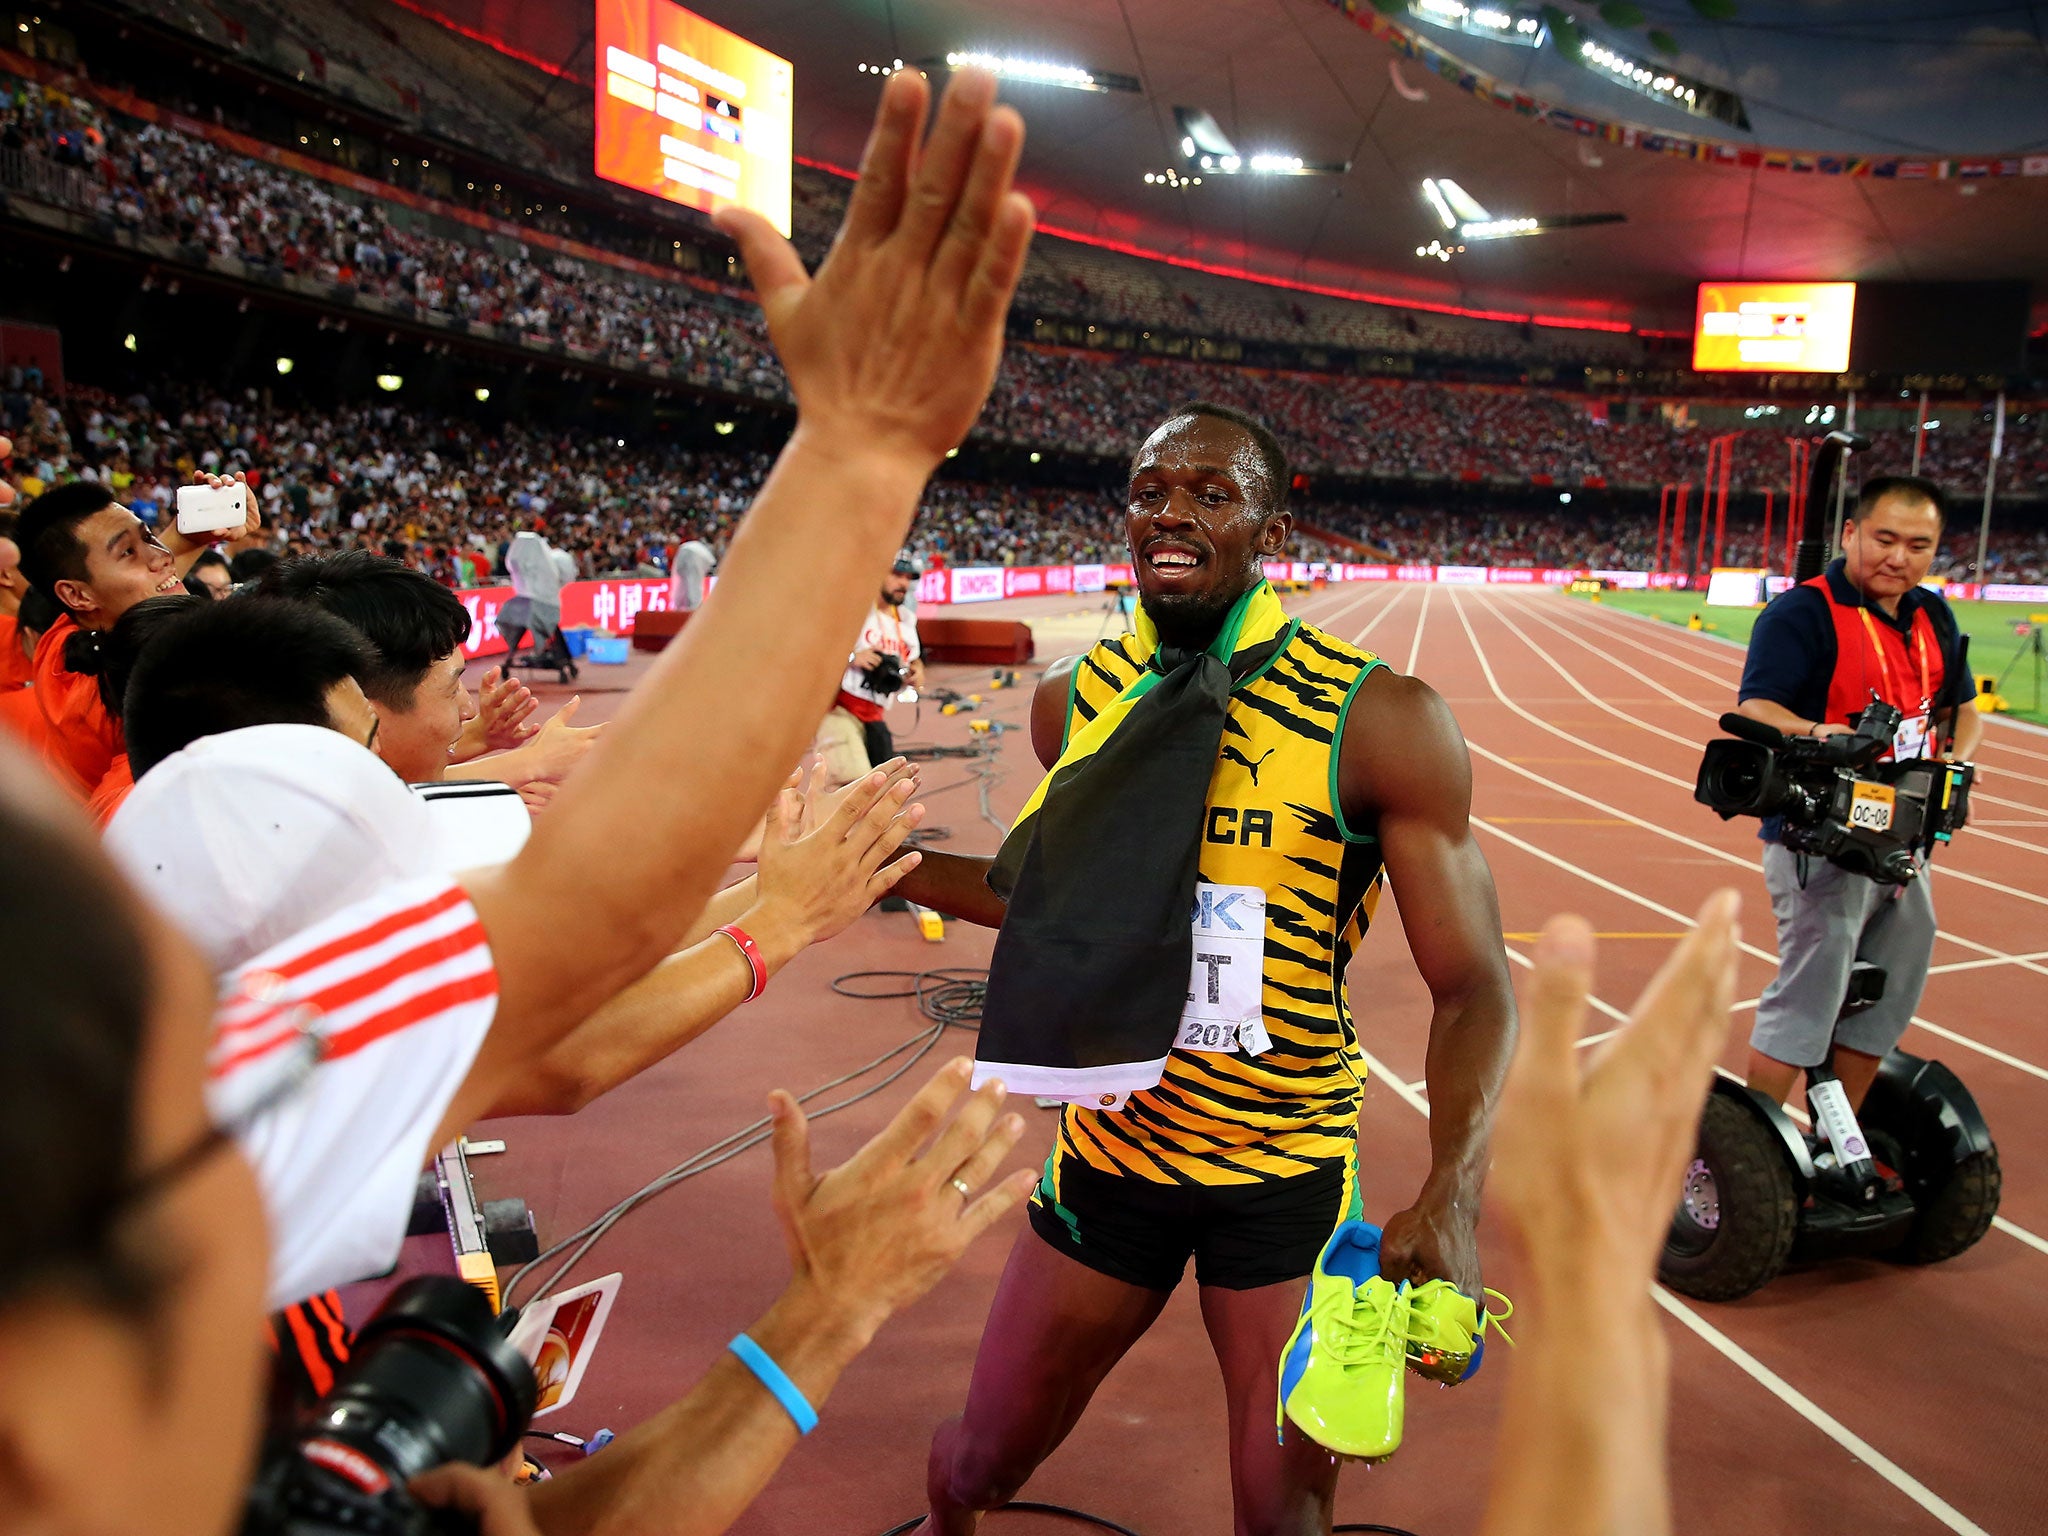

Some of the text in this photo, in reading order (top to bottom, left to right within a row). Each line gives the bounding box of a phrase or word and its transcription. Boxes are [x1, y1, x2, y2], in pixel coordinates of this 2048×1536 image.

[1203, 806, 1274, 848] CA
[1191, 890, 1246, 932] K
[1187, 951, 1232, 1006] T
